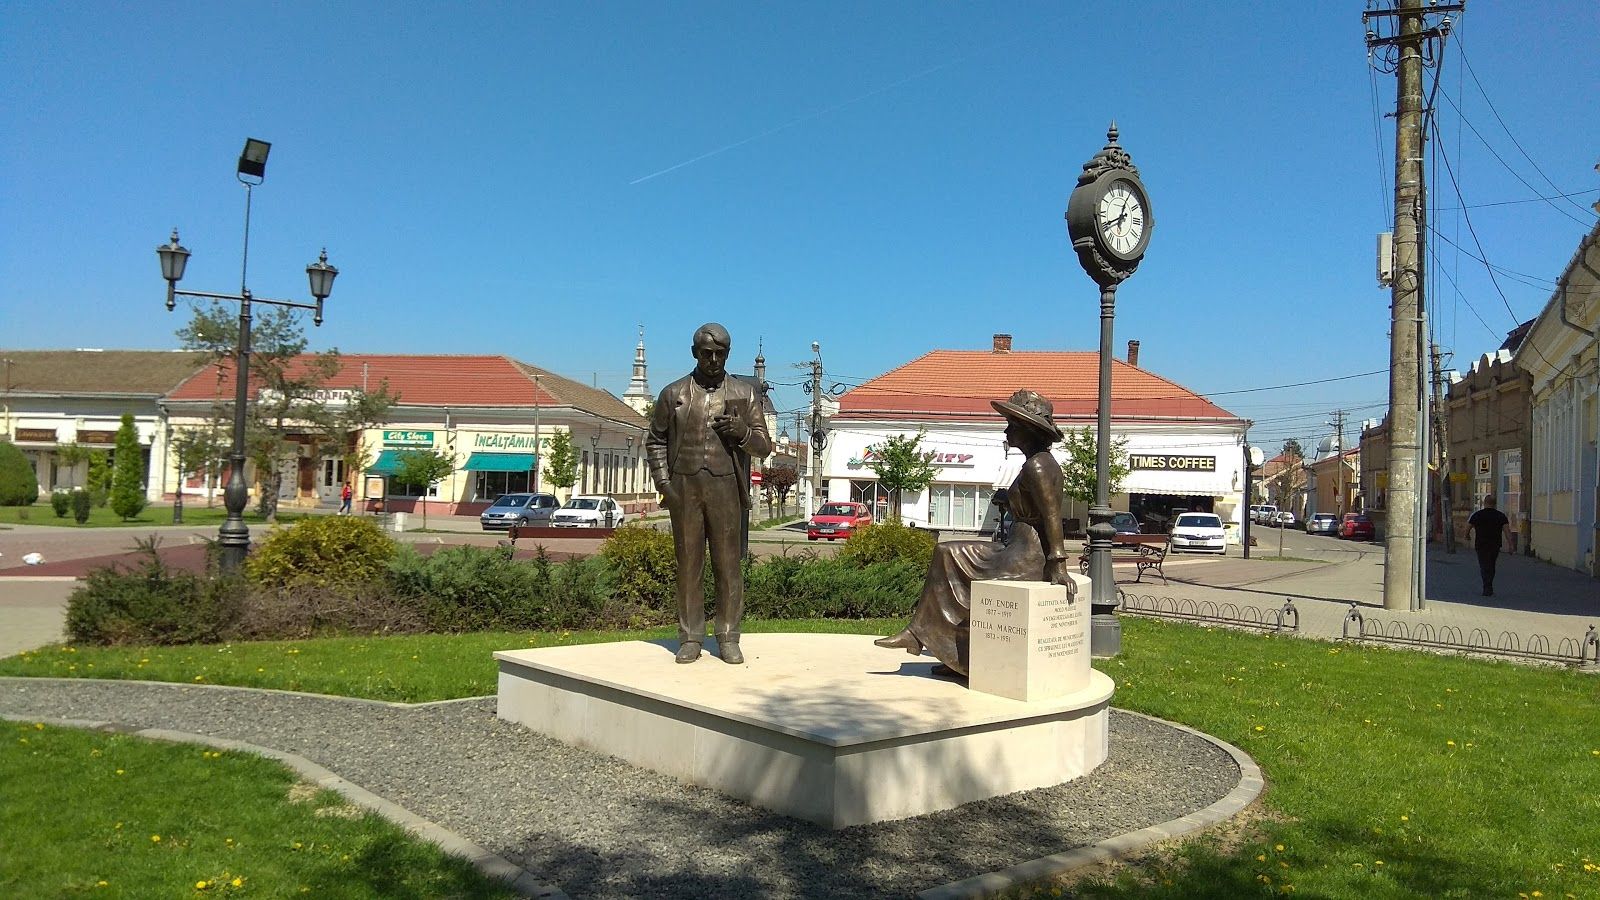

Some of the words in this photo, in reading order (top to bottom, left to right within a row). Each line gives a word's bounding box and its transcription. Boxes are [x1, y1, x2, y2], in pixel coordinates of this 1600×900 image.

[1131, 456, 1166, 468] TIMES
[1168, 457, 1214, 469] COFFEE
[980, 597, 993, 606] ADY
[996, 599, 1019, 610] ENDRE
[971, 619, 993, 631] OTILIA
